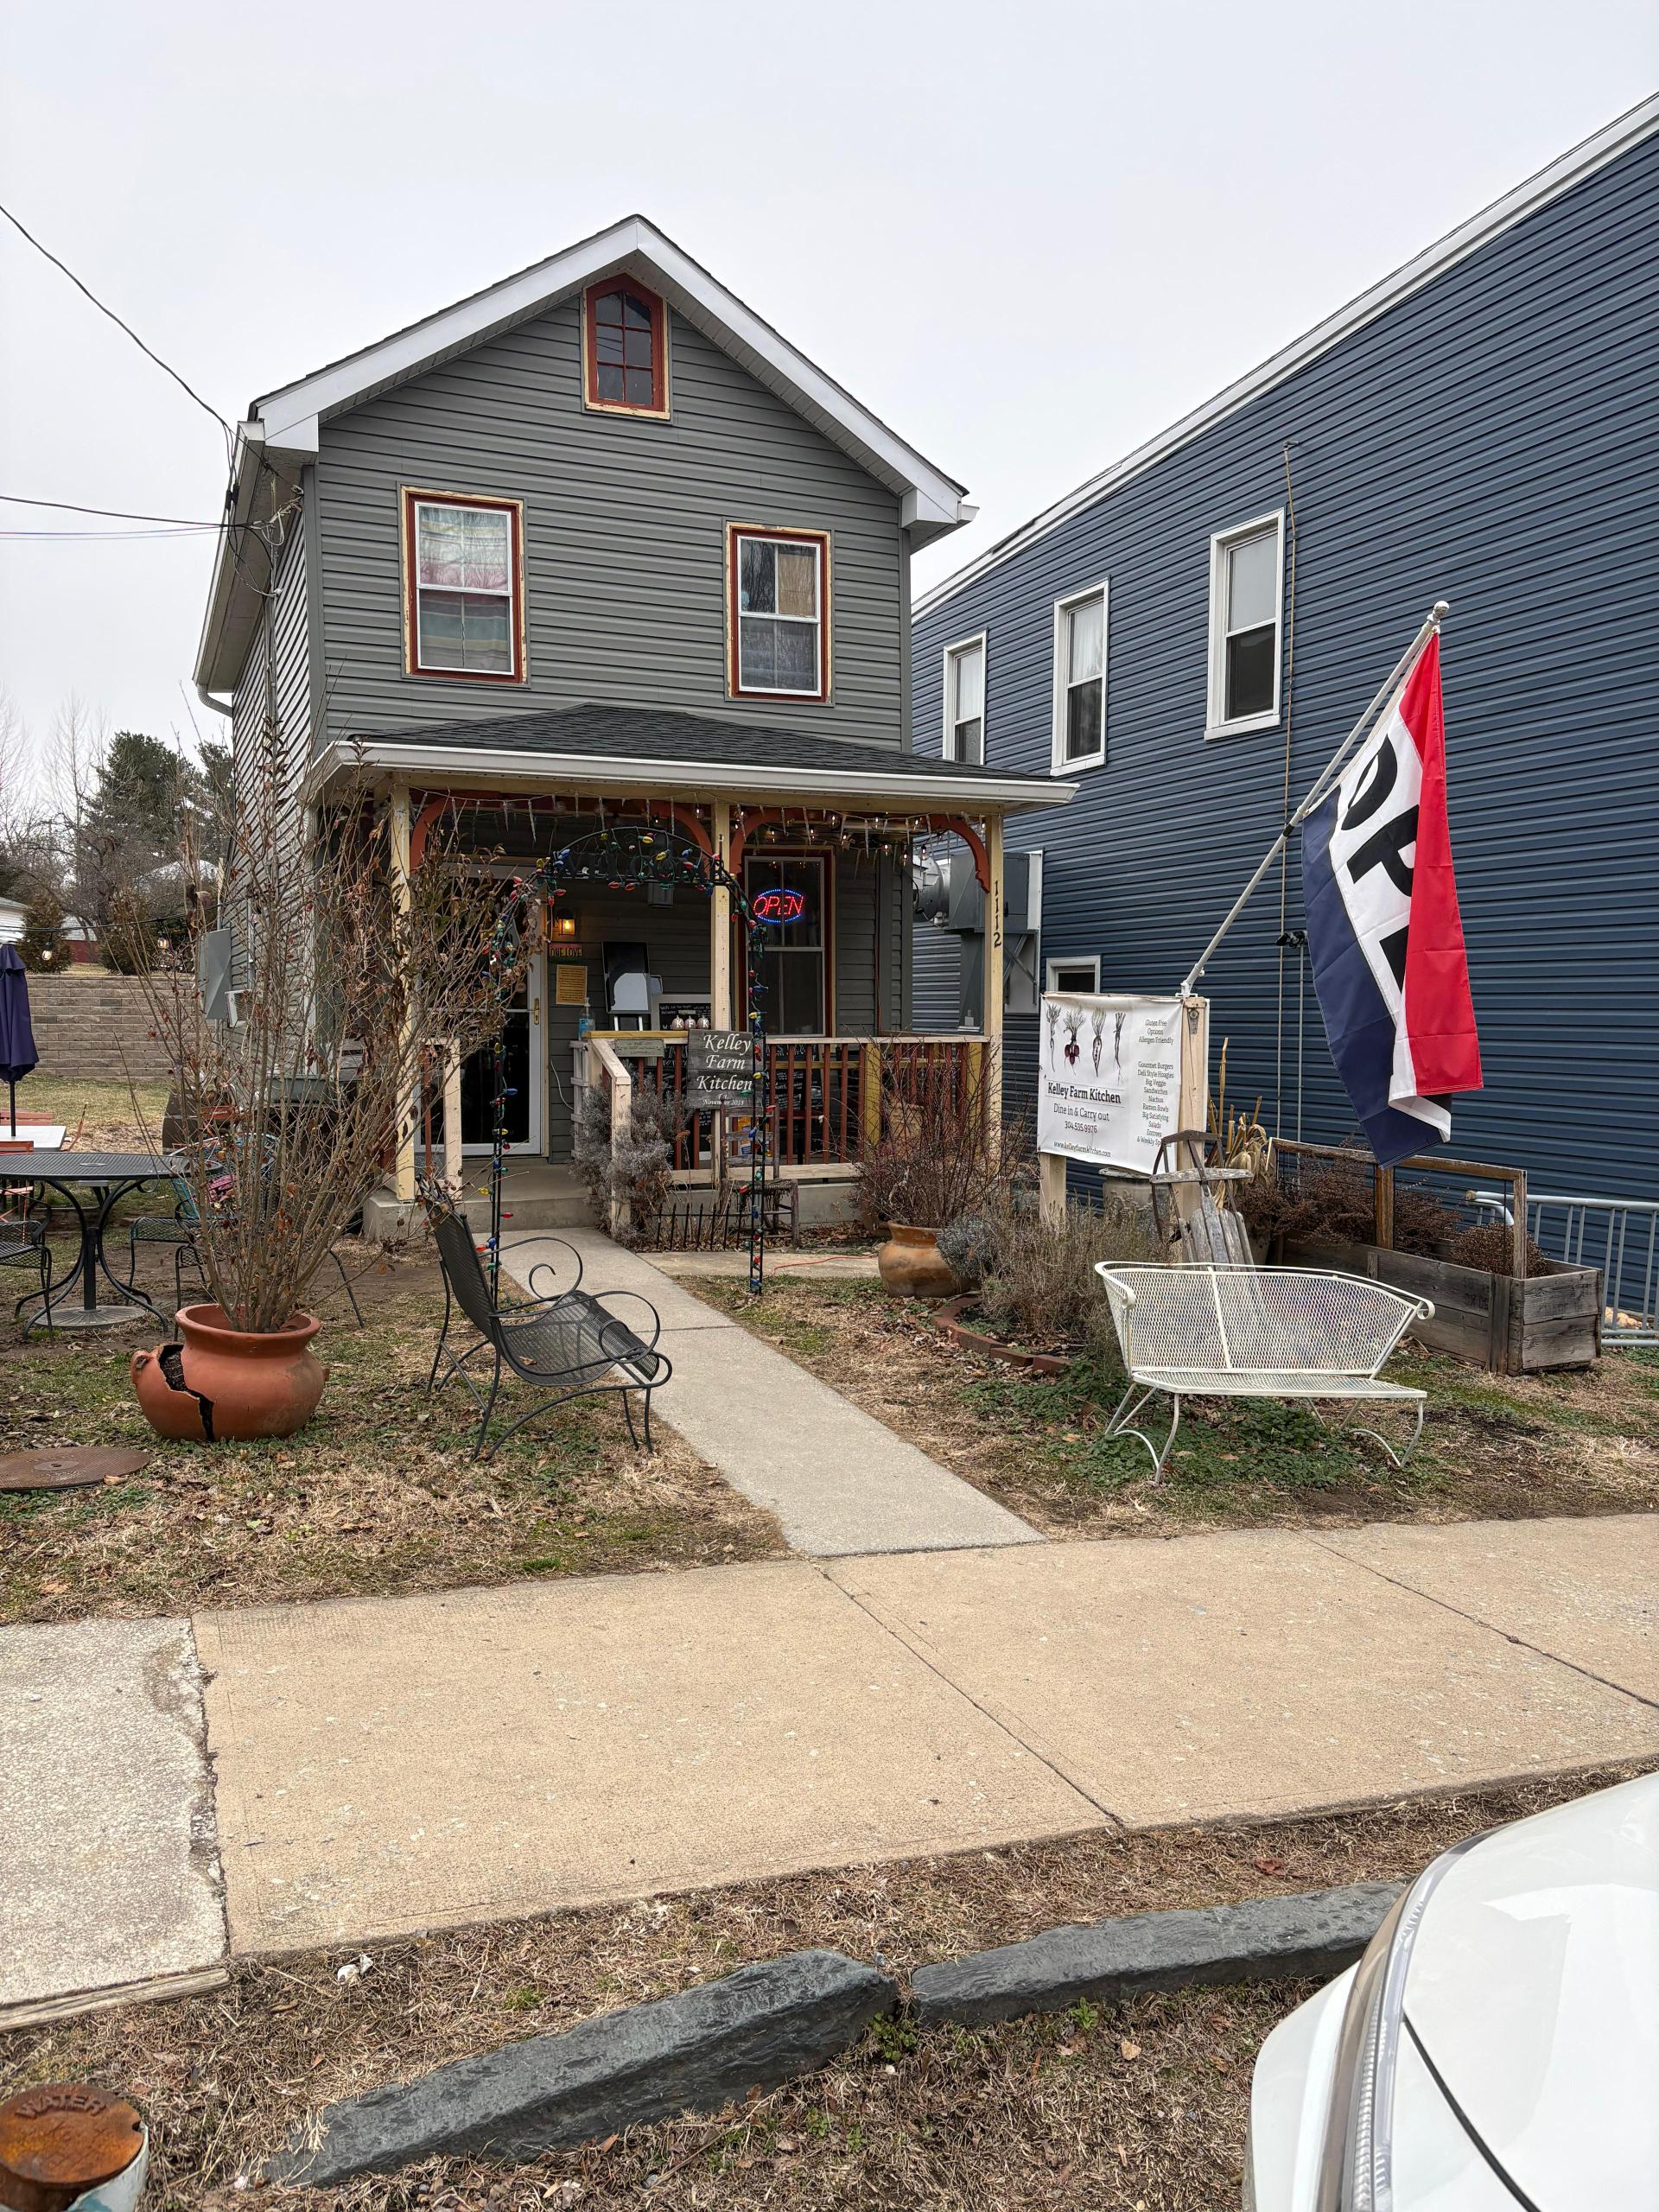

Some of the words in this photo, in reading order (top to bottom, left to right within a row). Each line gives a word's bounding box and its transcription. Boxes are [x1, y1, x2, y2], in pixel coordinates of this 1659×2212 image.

[753, 895, 804, 916] OPEN
[994, 880, 1002, 948] 1112
[550, 947, 564, 957] ONE
[565, 947, 582, 957] LOVE
[677, 1020, 683, 1028] K
[689, 1020, 694, 1028] F
[702, 1019, 709, 1028] K
[703, 1033, 752, 1056] Kelley
[706, 1055, 746, 1070] Farm
[1158, 1063, 1174, 1071] Burgers
[696, 1075, 753, 1092] Kitchen
[1154, 1079, 1166, 1088] Veggie
[1048, 1083, 1069, 1100] Kelley
[1071, 1086, 1088, 1099] Farm
[1090, 1089, 1122, 1104] Kitchen
[1054, 1103, 1067, 1114] Dine
[1067, 1106, 1073, 1116] in
[1074, 1108, 1079, 1116] &
[1080, 1108, 1097, 1122] Carry
[1098, 1112, 1109, 1122] out
[1150, 1113, 1169, 1122] Satisfying
[1054, 1141, 1111, 1158] www.kelleyfarmkitchen.com
[1141, 1137, 1154, 1147] Weekly
[14, 2094, 108, 2120] WATER
